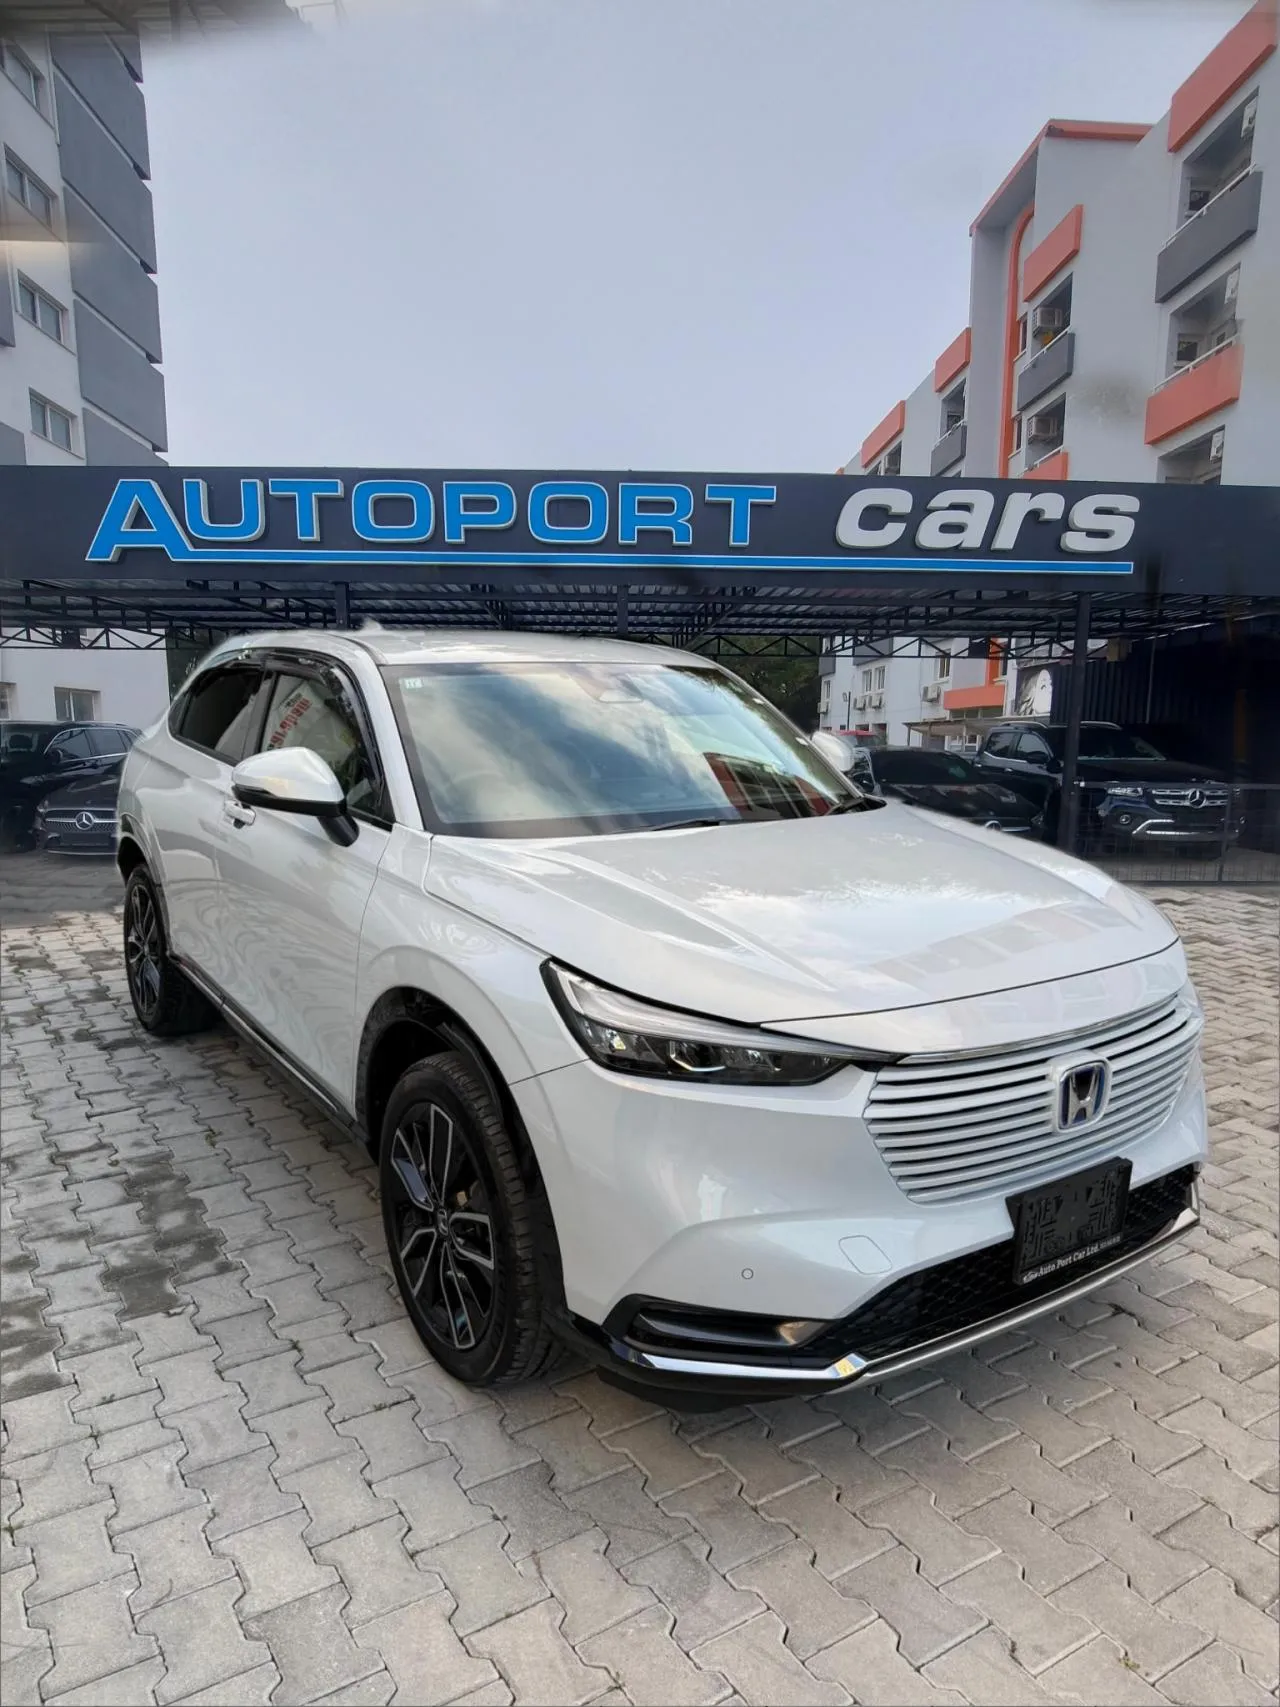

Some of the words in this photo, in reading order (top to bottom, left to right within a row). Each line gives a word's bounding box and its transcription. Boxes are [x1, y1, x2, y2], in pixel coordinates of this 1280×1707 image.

[85, 478, 778, 563] AUTOPORT
[834, 487, 1141, 553] cars
[1038, 1262, 1056, 1277] Auto
[1056, 1255, 1072, 1270] Port
[1073, 1249, 1086, 1262] Car
